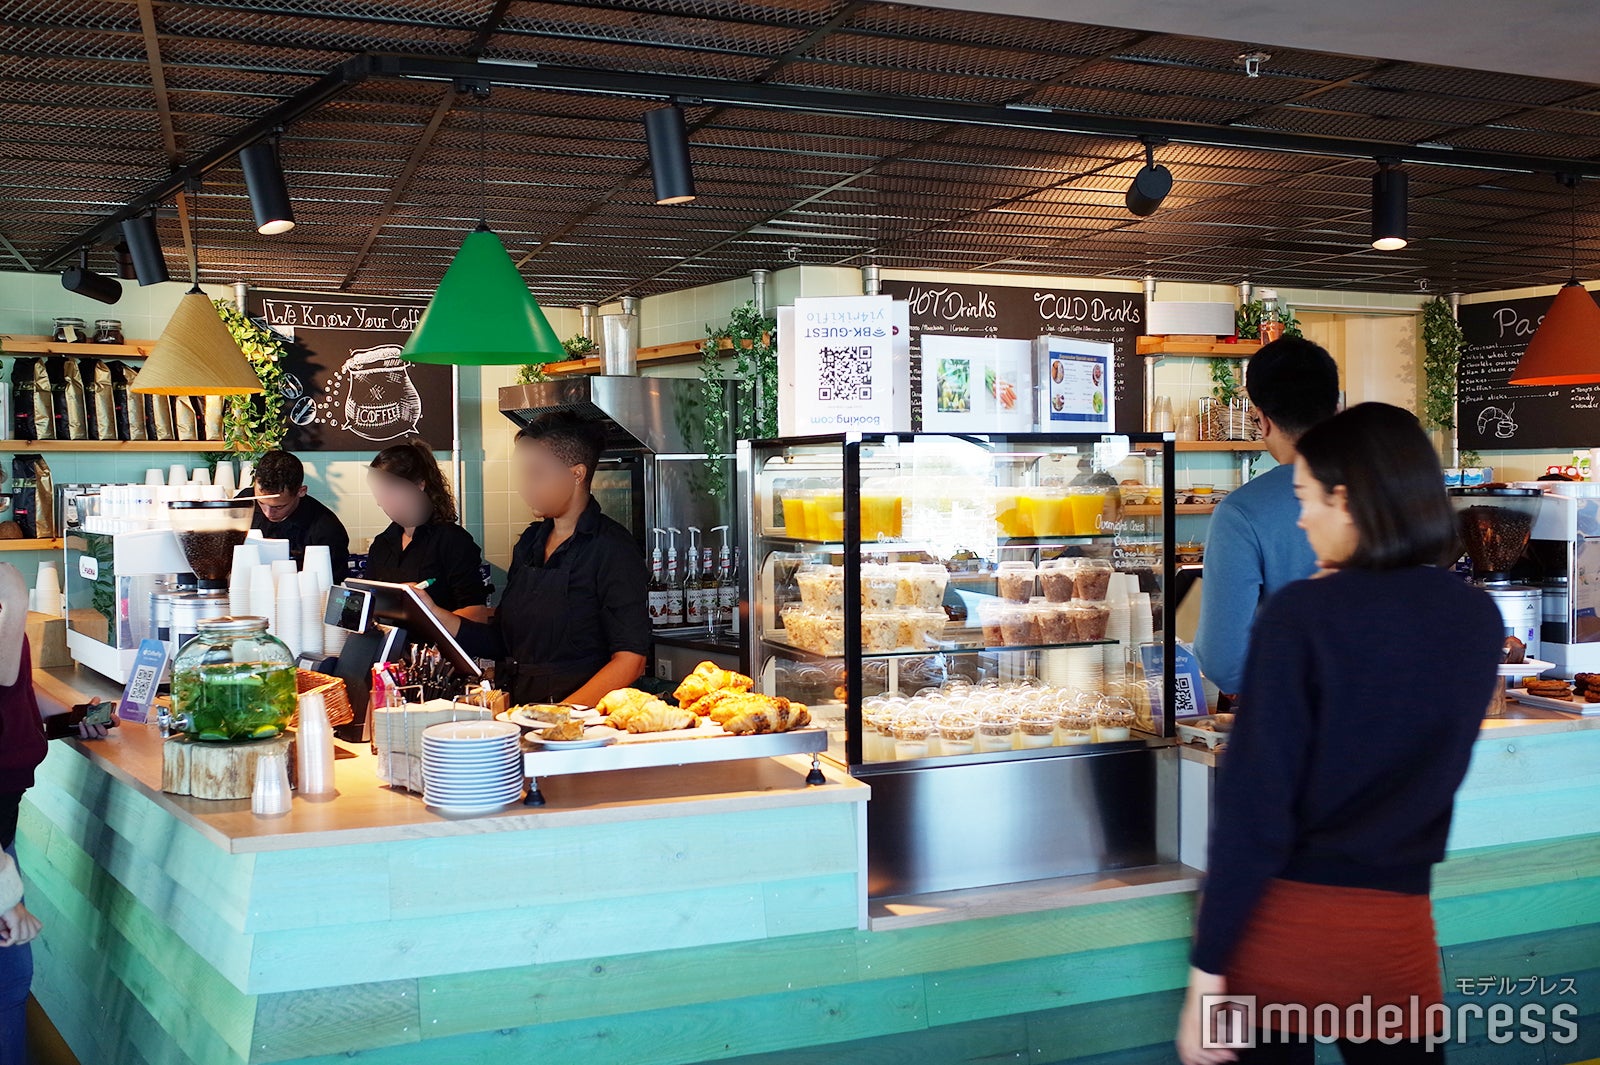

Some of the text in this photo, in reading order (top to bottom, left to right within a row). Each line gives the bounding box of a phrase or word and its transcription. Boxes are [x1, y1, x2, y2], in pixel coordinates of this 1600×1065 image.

[906, 287, 948, 317] HOT
[1033, 292, 1088, 320] COLD
[267, 303, 296, 324] We
[301, 306, 351, 328] Know
[353, 307, 389, 328] Your
[805, 327, 871, 338] BK-GUEST
[1488, 351, 1508, 359] wheat
[1575, 393, 1595, 406] Candy
[360, 407, 397, 423] COFFEE
[810, 414, 881, 425] Booking.com
